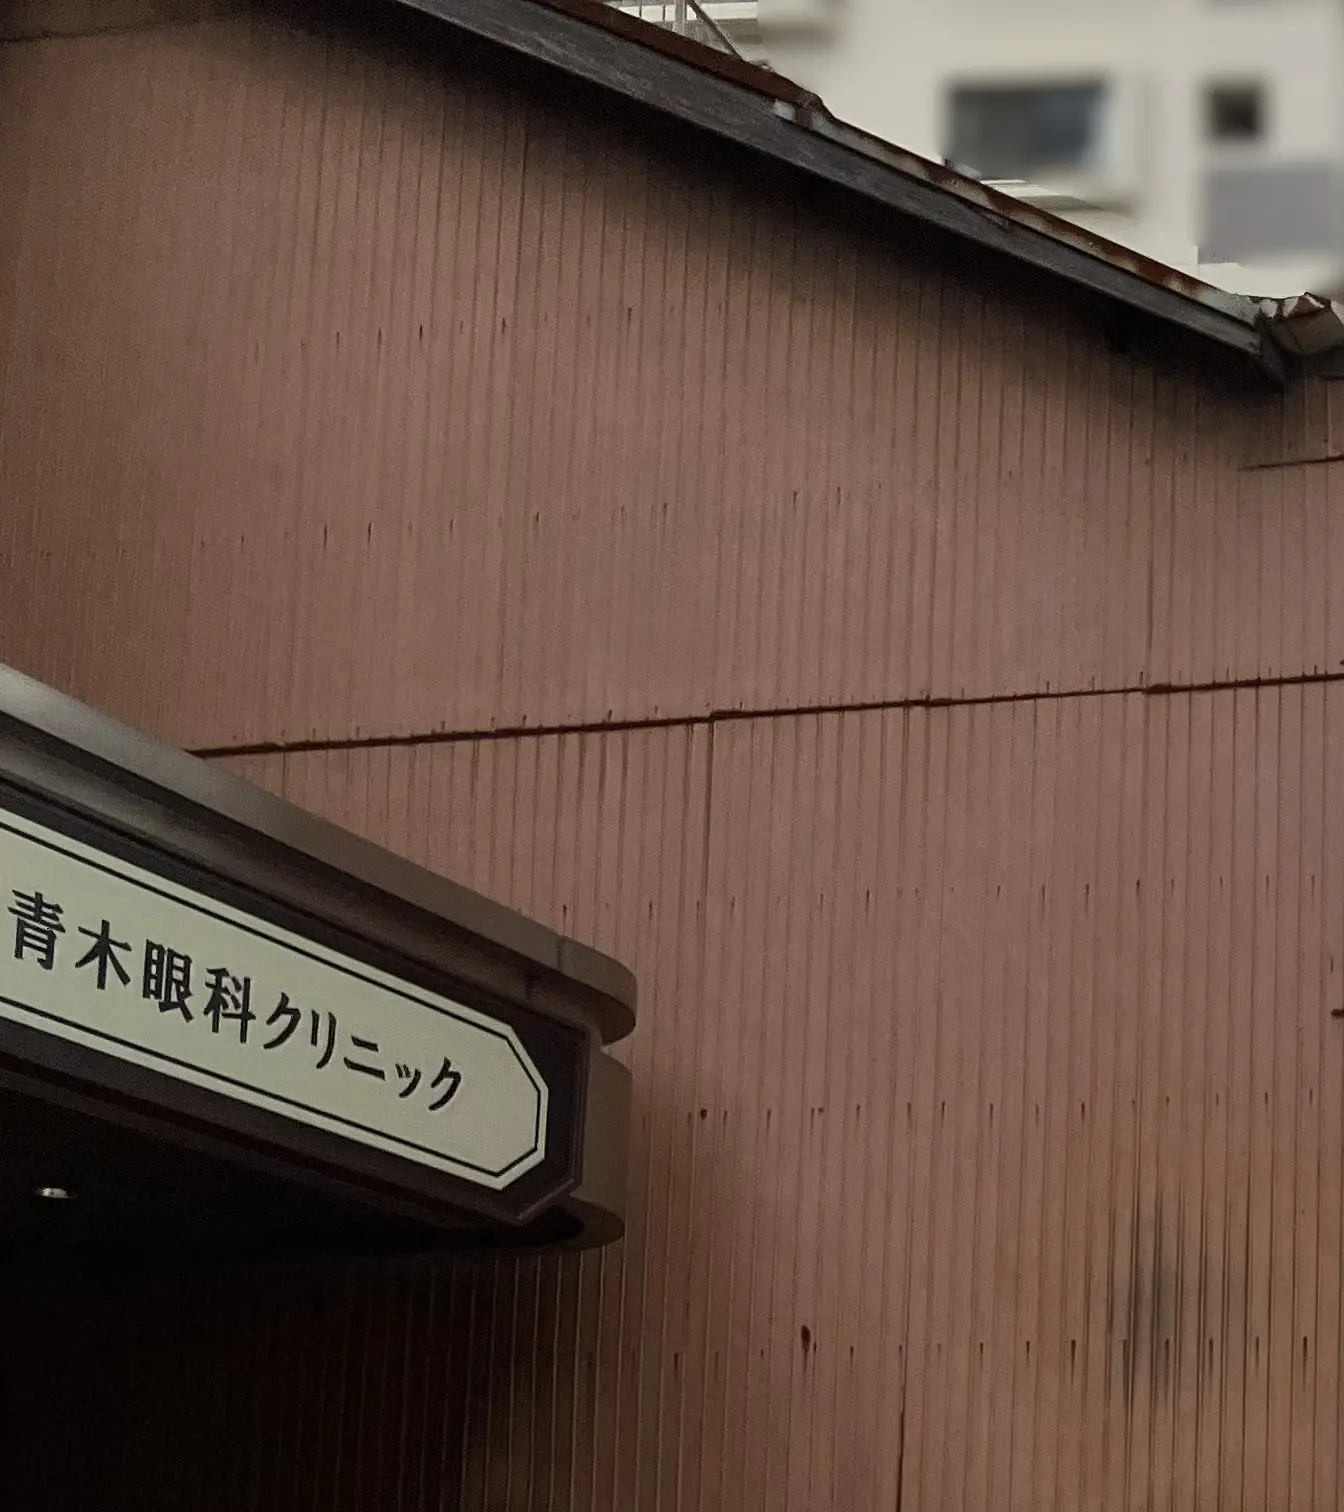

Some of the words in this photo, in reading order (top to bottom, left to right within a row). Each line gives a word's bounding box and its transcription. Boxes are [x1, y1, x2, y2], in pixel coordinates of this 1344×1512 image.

[8, 888, 463, 1112] 青木眼科クリニック
